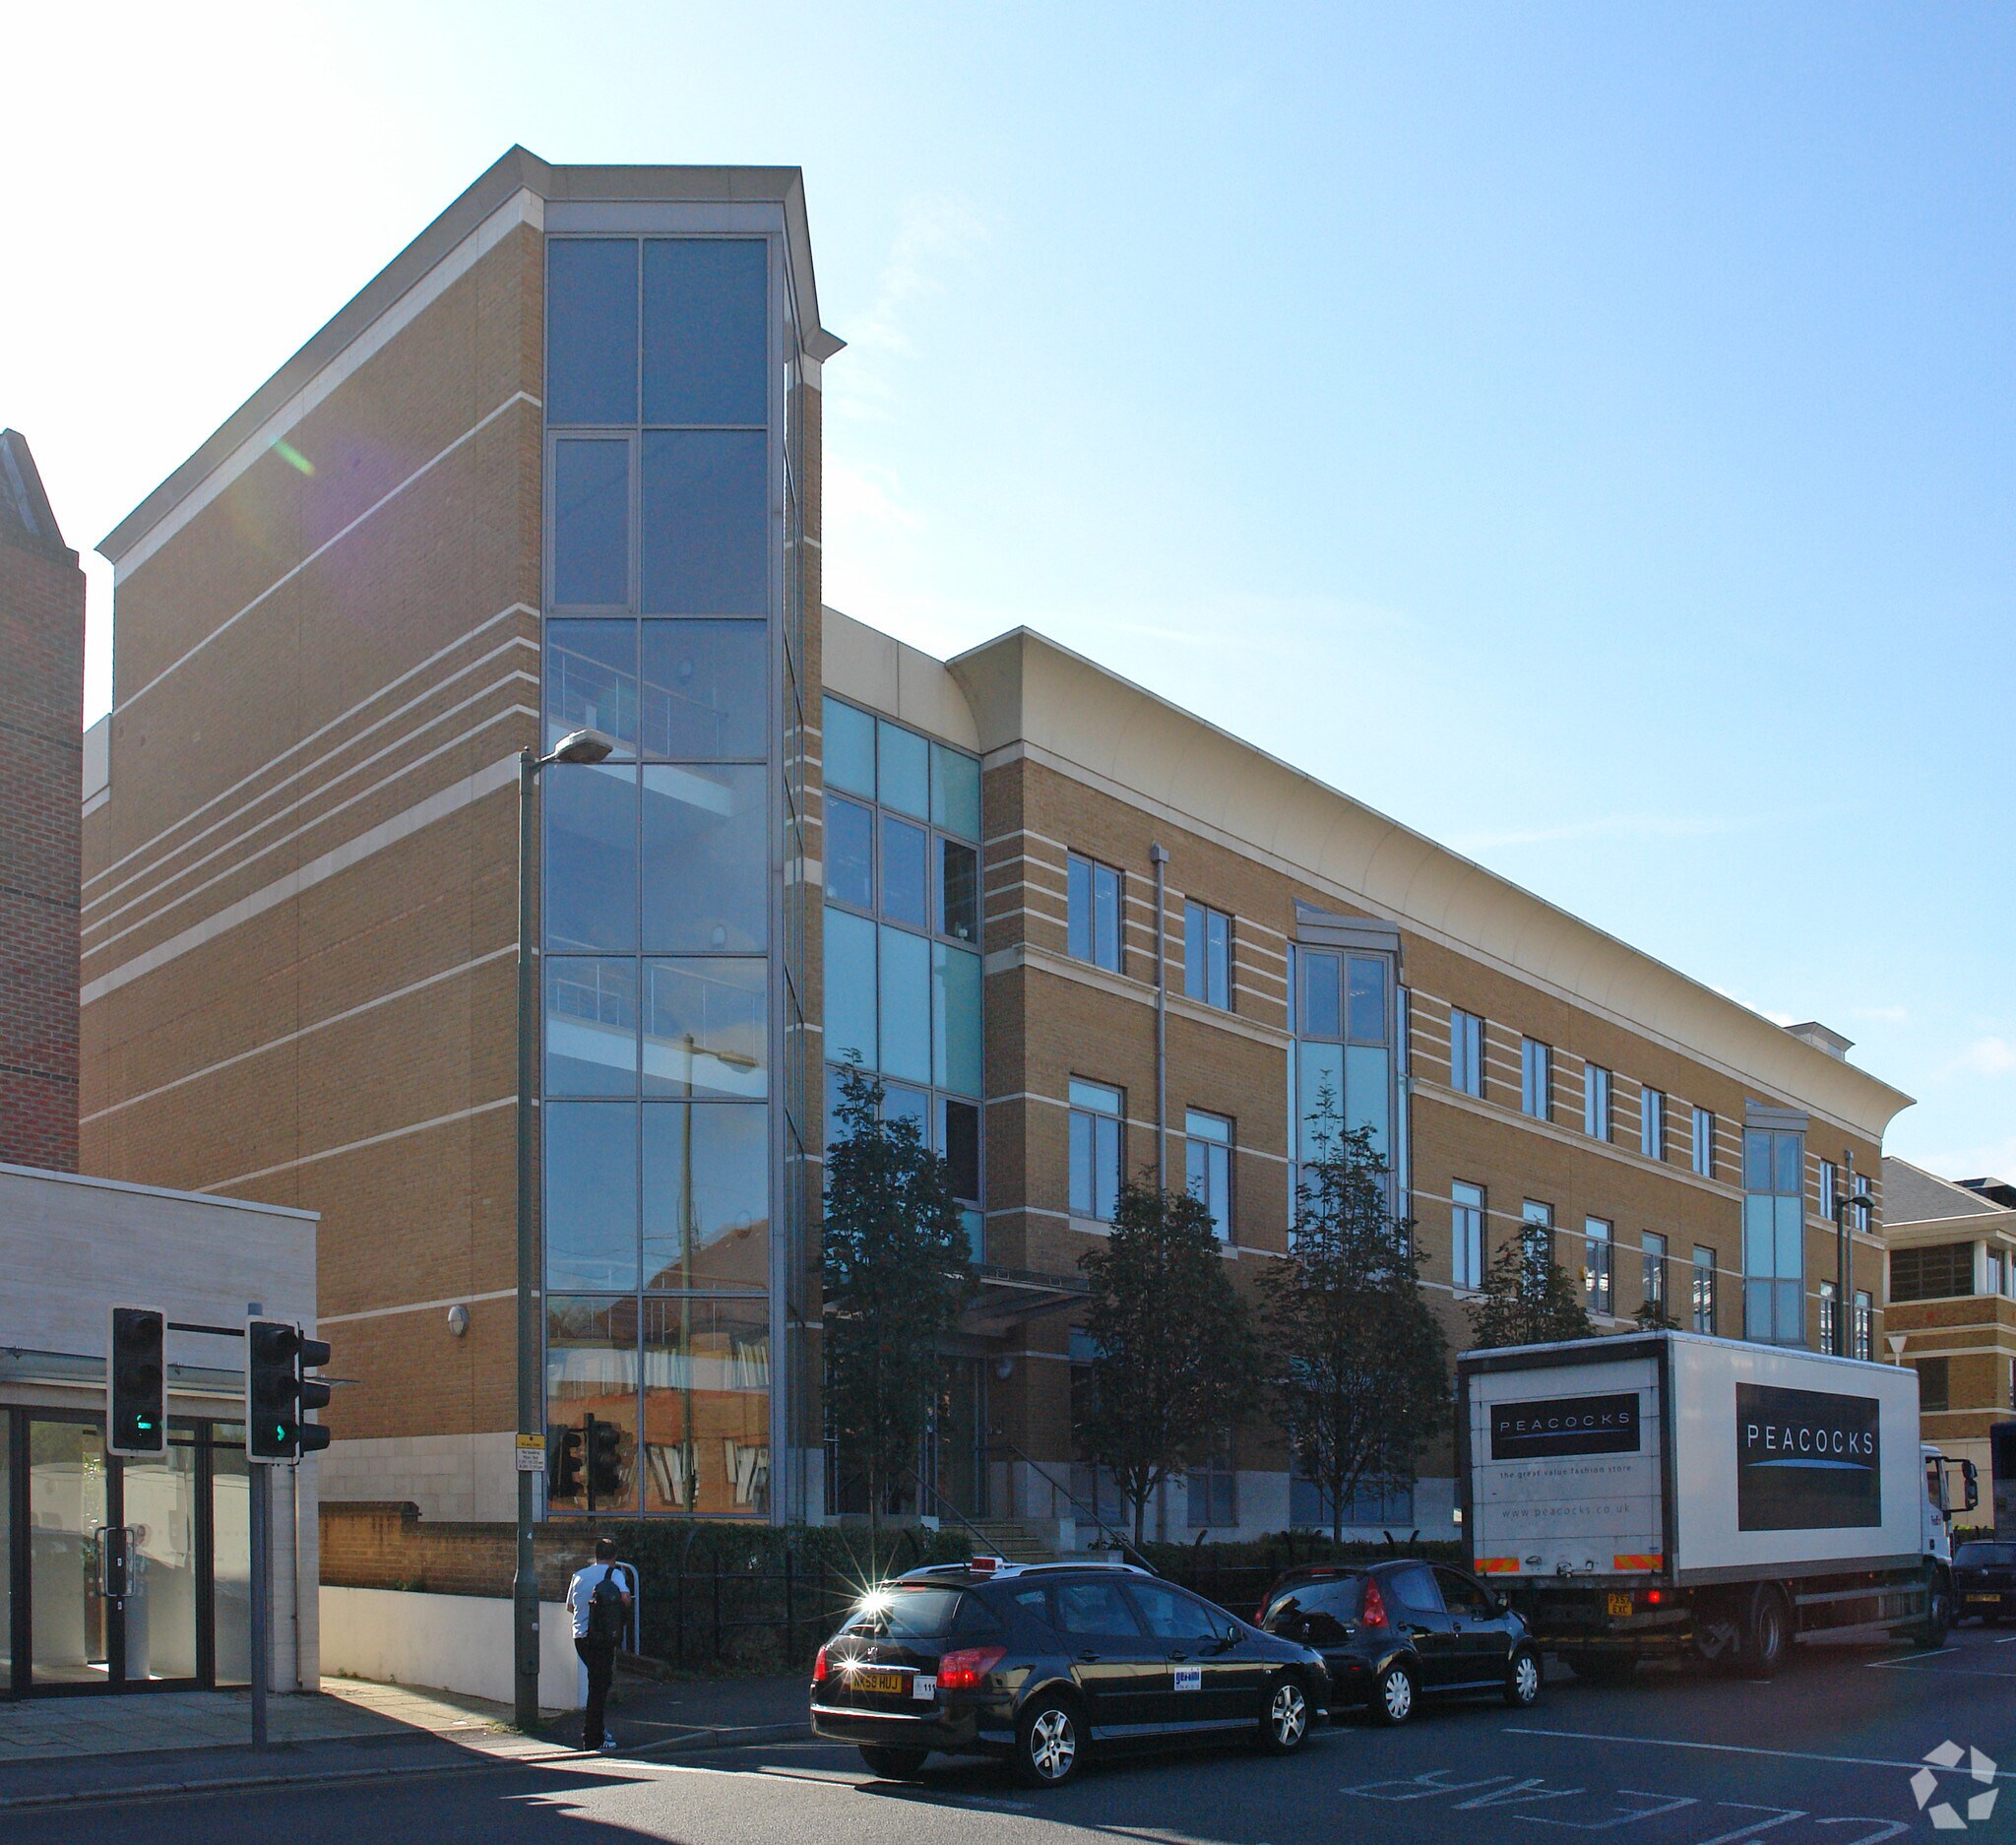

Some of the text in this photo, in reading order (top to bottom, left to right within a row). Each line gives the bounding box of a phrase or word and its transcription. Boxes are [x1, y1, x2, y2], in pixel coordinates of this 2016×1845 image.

[1499, 1412, 1630, 1431] PEACOCKS
[1747, 1424, 1873, 1454] PEACOCKS
[1517, 1470, 1540, 1479] great
[1502, 1503, 1630, 1518] www.peacocks.co.uk
[879, 1676, 898, 1689] HUJ
